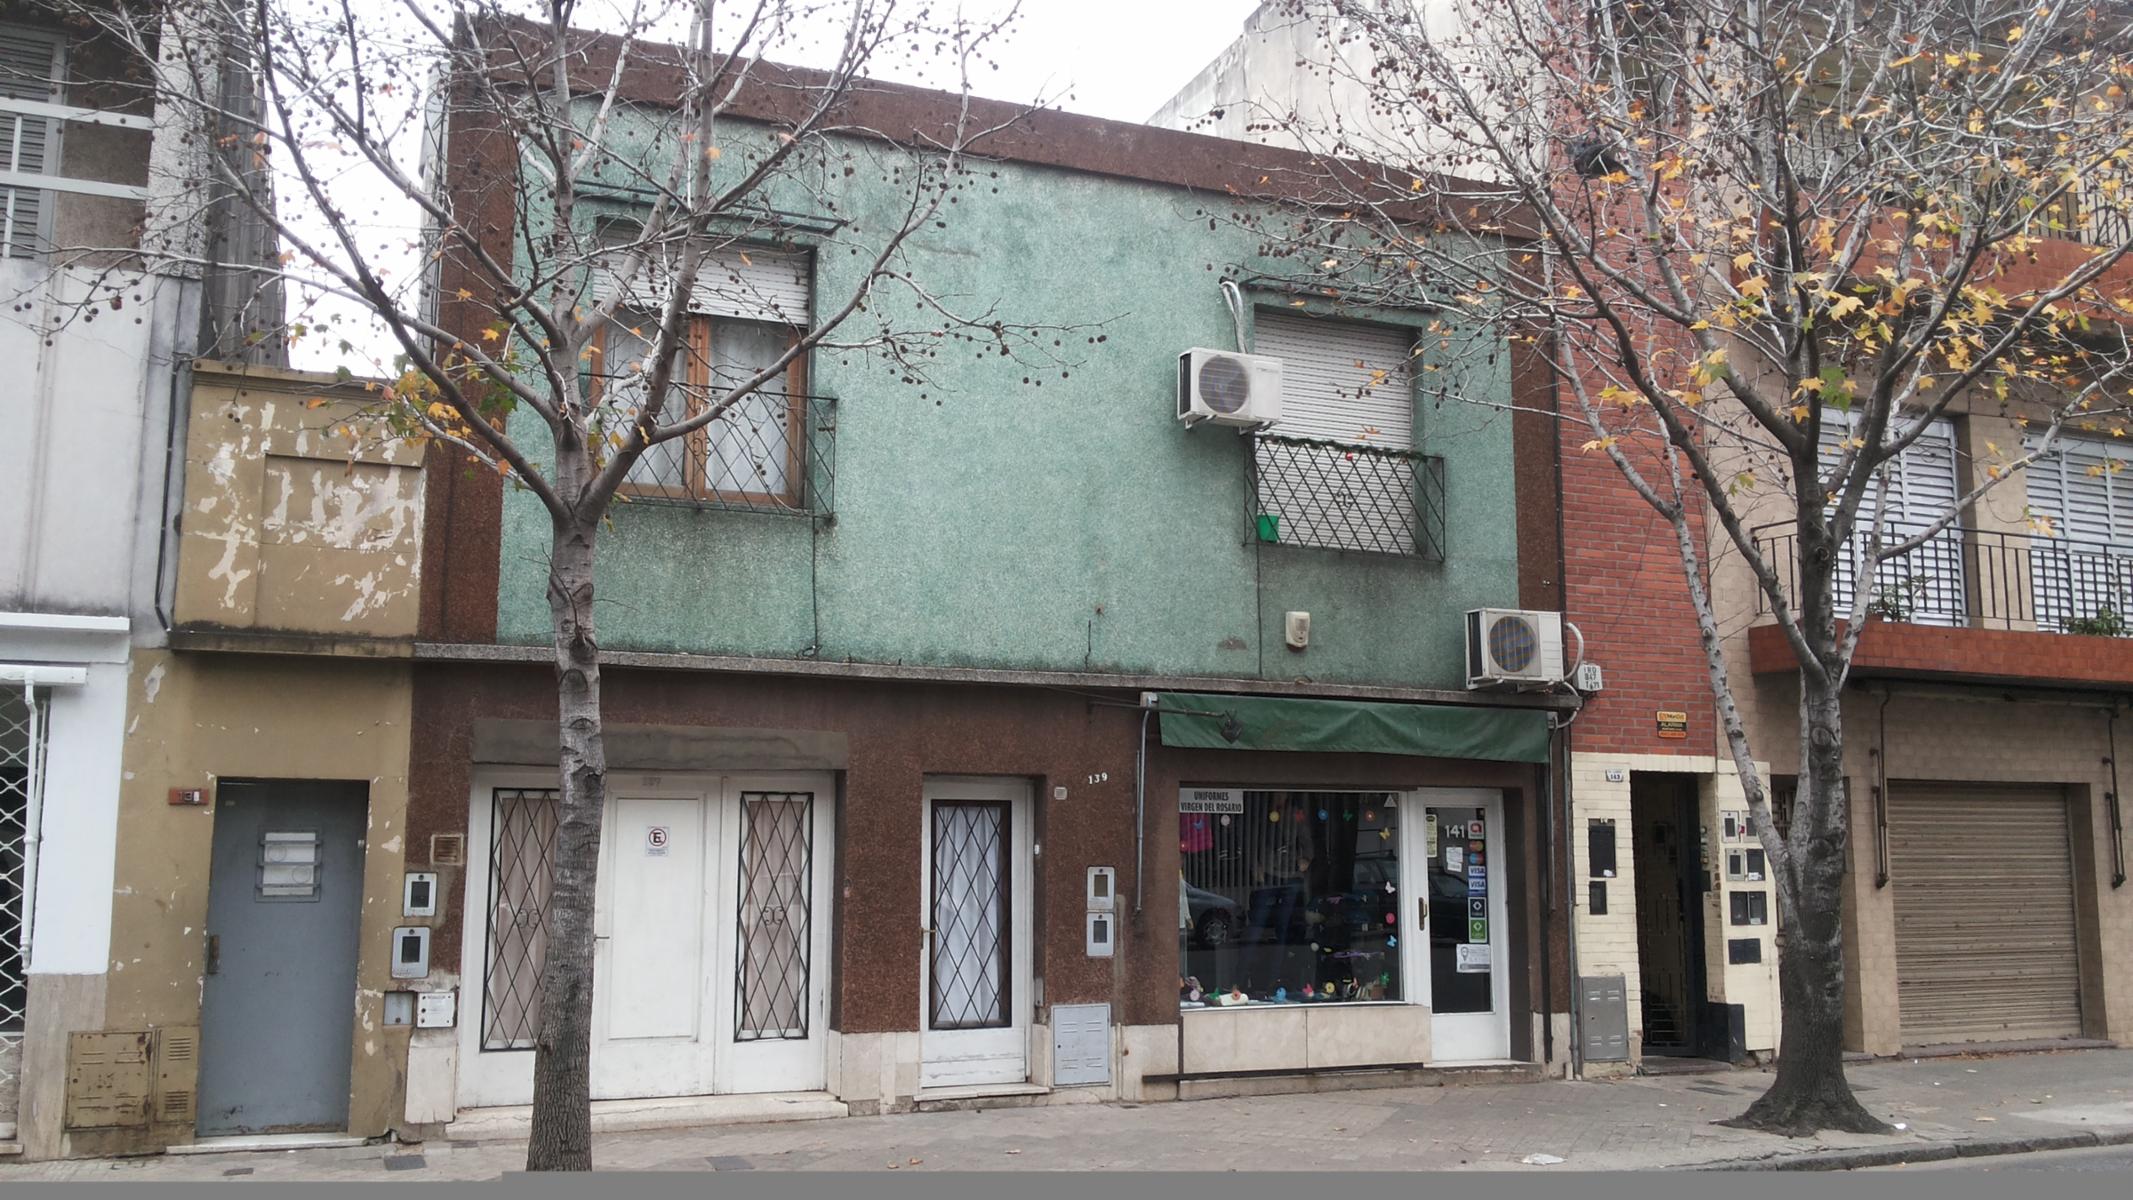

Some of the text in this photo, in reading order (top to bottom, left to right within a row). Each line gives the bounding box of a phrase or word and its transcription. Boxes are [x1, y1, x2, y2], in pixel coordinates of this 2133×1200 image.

[1088, 771, 1108, 785] 139
[1193, 791, 1229, 801] UNIFORMES
[1180, 802, 1242, 812] VIRGEN DEL ROSARIO
[1445, 824, 1465, 838] 141
[1471, 880, 1485, 888] VISA
